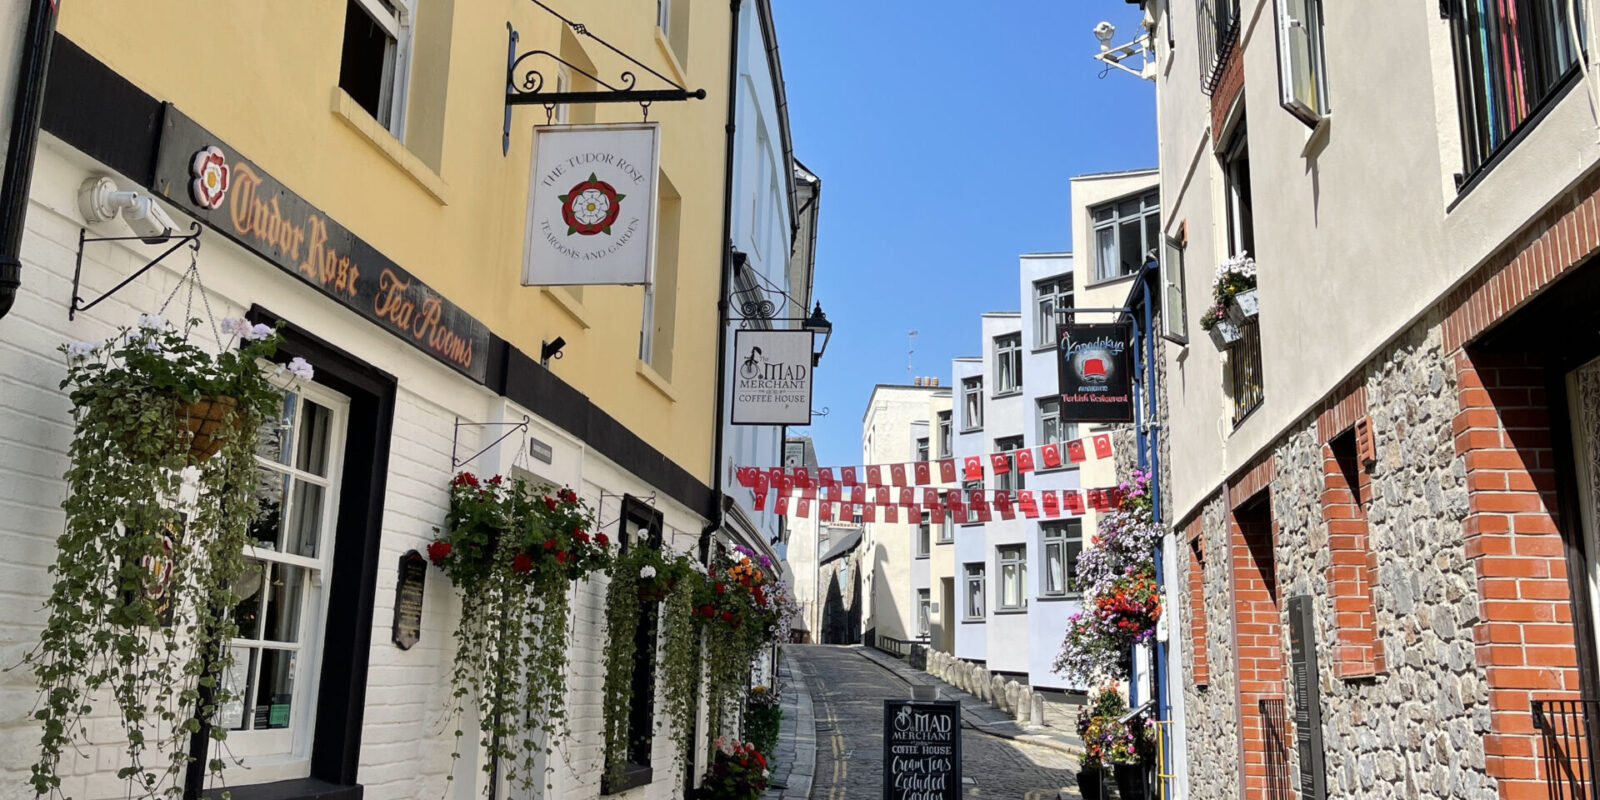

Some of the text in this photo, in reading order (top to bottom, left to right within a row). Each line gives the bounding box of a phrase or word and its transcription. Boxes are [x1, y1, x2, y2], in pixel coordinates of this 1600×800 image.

[541, 152, 645, 188] THE TUDOR ROSE
[541, 217, 640, 261] TEAROOMS AND GARDEN
[230, 162, 474, 369] Tudor Rose Tea Rooms
[764, 362, 806, 381] MAD
[739, 380, 806, 389] MERCHANT
[738, 394, 805, 403] COFFEE HOUSE
[915, 713, 952, 733] MAD
[892, 732, 952, 741] MERCHANT
[891, 745, 952, 755] COFFEE HOUSE
